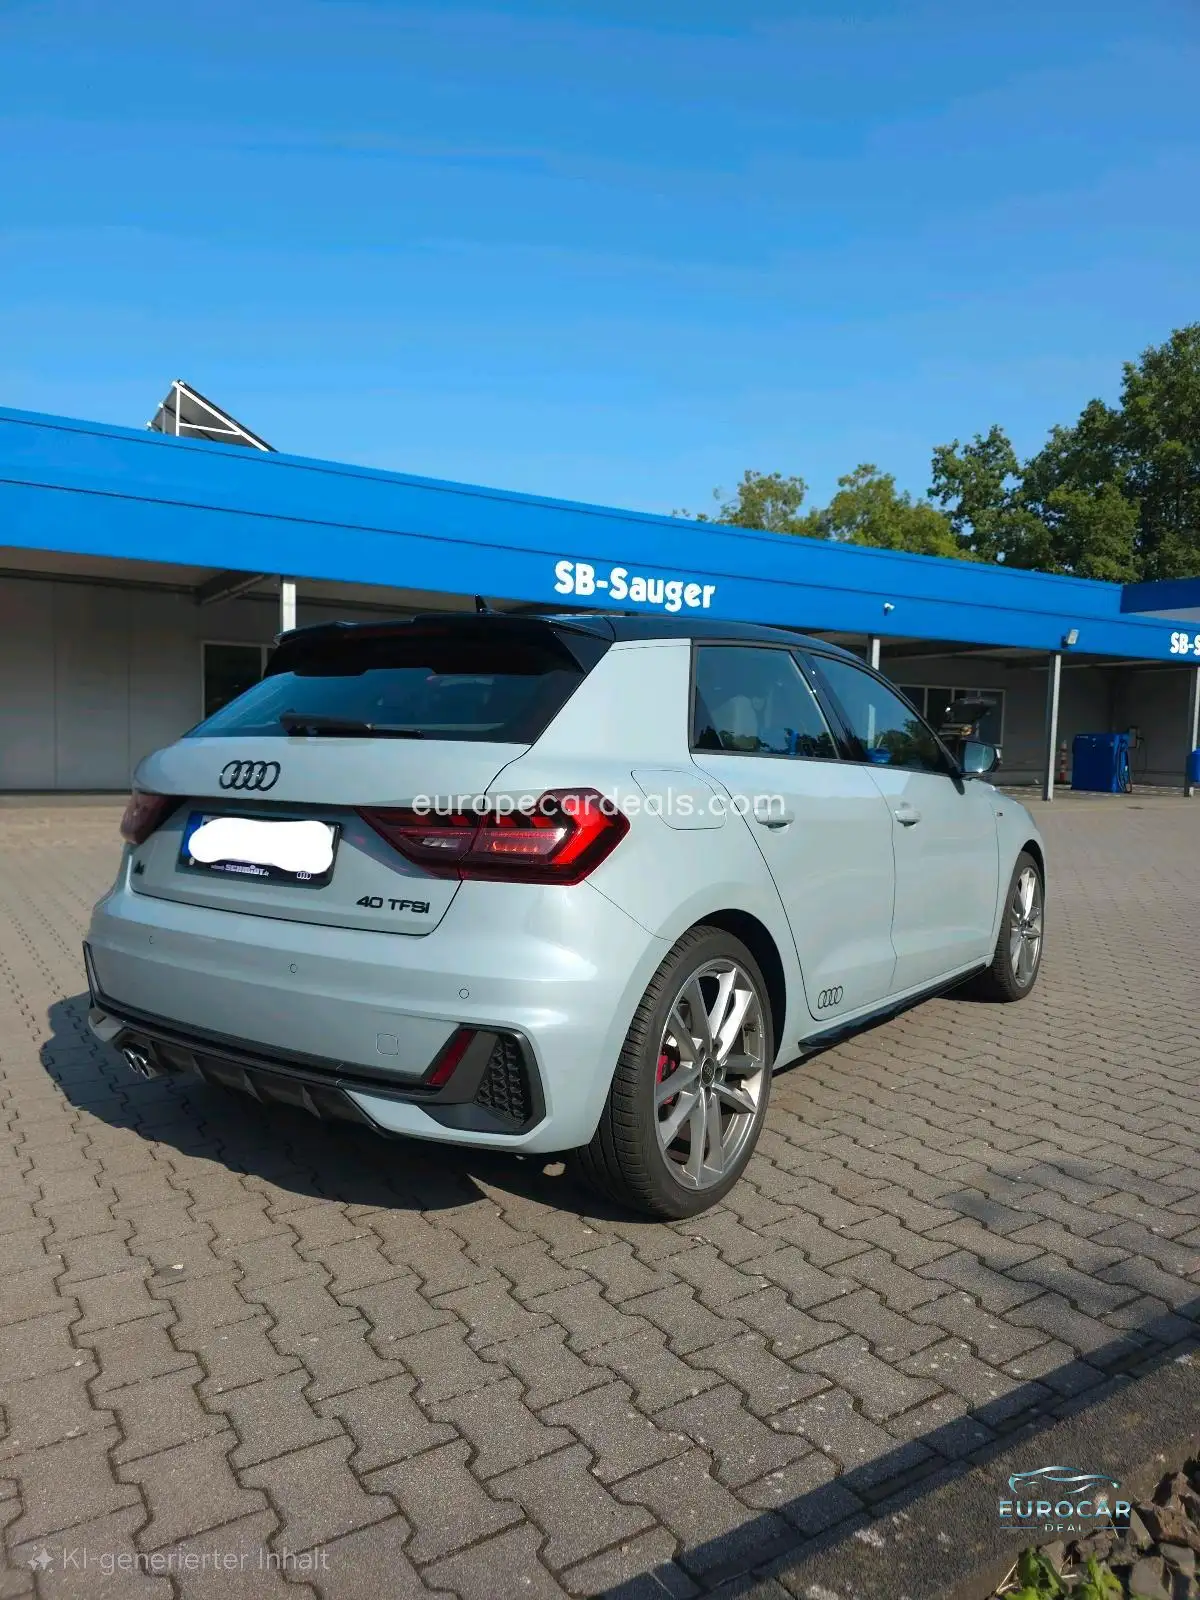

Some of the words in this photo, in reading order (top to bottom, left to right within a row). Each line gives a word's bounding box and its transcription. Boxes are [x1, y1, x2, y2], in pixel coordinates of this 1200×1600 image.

[554, 560, 716, 613] SB-Sauger
[356, 896, 383, 909] 40
[388, 898, 430, 914] TFSI
